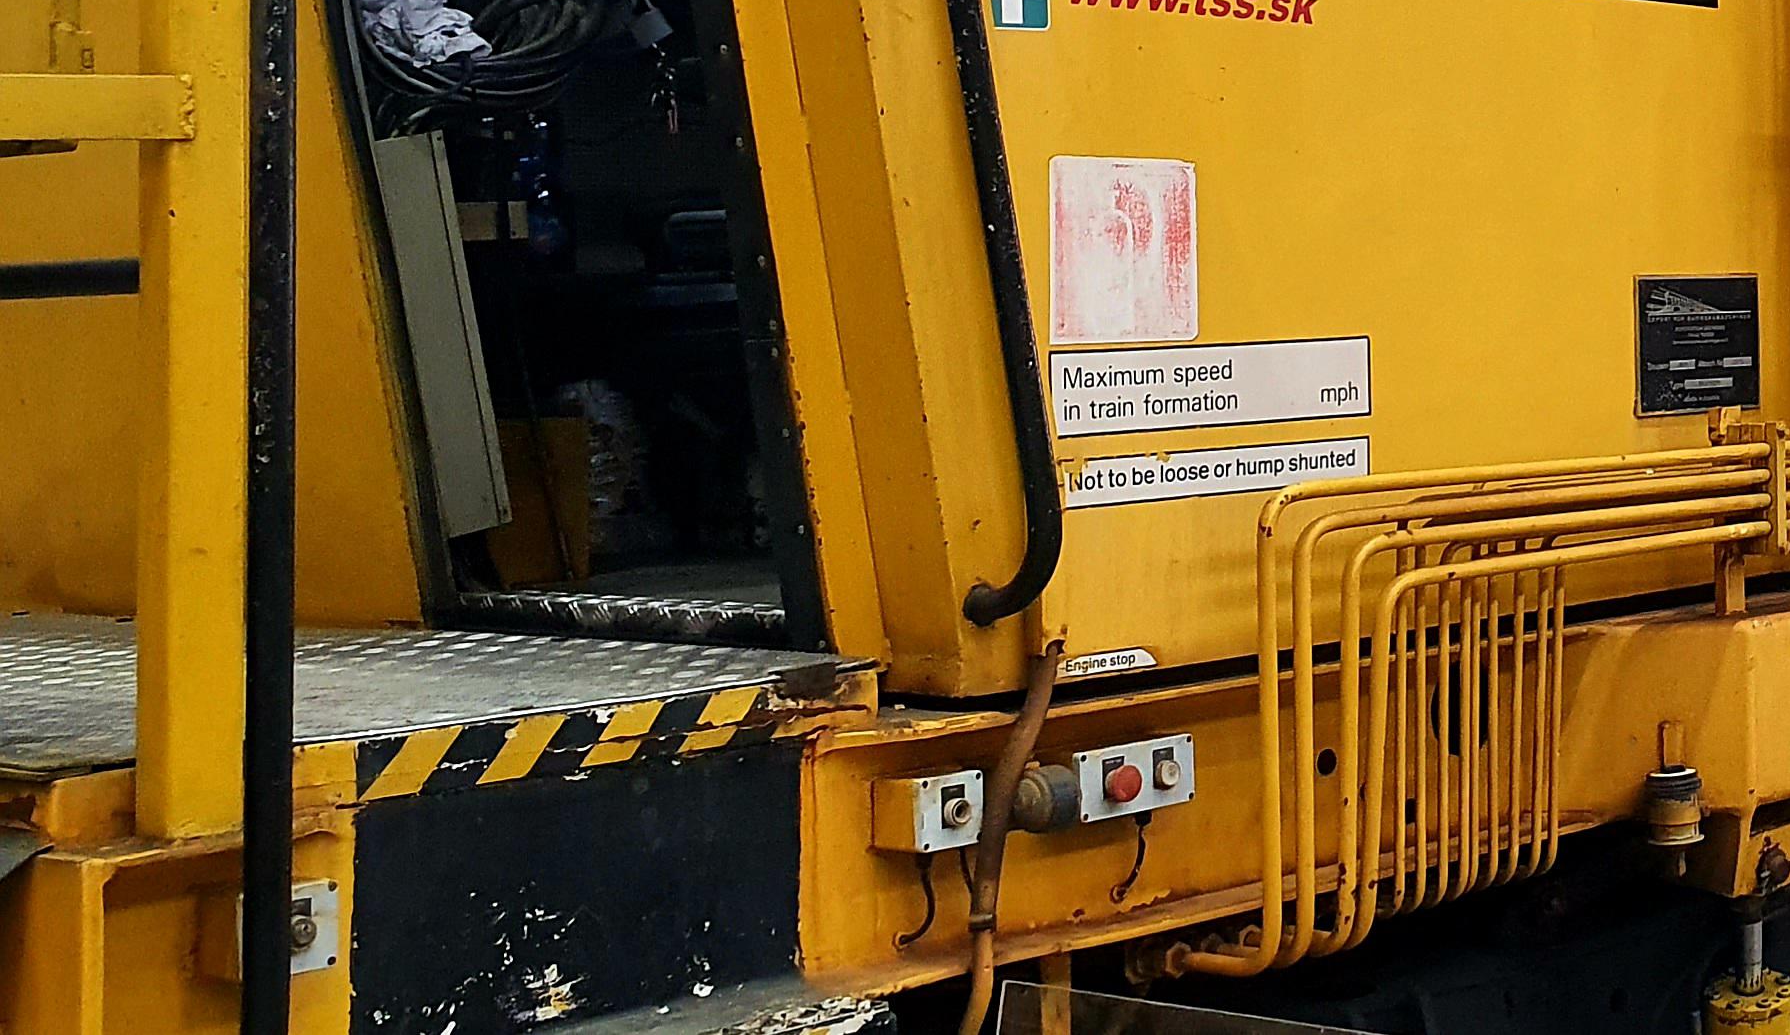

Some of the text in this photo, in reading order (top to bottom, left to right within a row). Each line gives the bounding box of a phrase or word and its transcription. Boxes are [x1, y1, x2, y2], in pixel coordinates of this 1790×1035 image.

[1063, 359, 1233, 390] Maximum speed
[1064, 389, 1238, 421] in train formation
[1321, 381, 1359, 406] mph
[1068, 449, 1356, 492] Not to be loose or hump shunted
[1065, 653, 1136, 674] Engine stop
